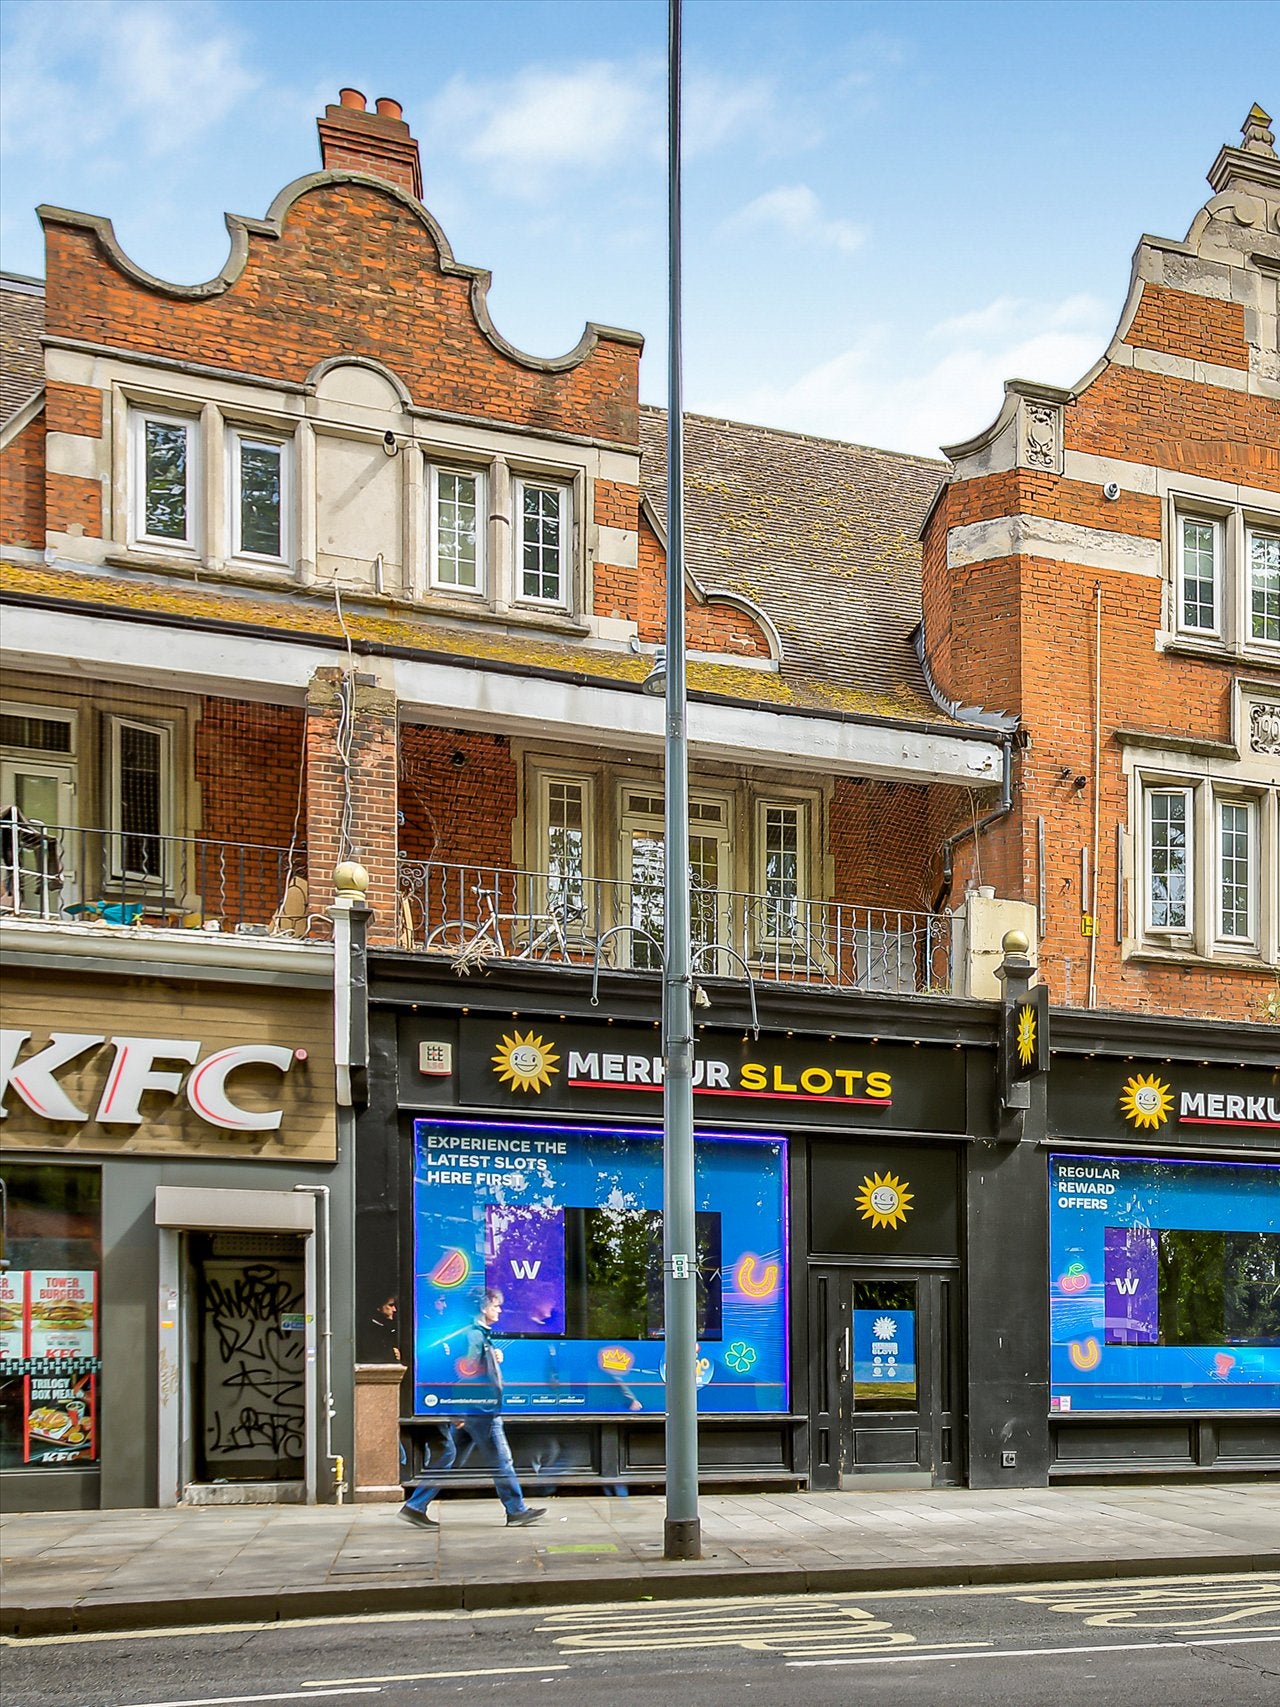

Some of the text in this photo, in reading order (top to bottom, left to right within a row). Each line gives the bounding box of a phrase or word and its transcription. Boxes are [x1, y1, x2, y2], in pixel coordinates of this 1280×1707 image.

[0, 1029, 294, 1130] KFC
[739, 1063, 892, 1098] SLOTS
[427, 1136, 567, 1154] EXPERIENCE THE
[427, 1153, 547, 1170] LATEST SLOTS
[427, 1171, 523, 1186] HERE FIRST
[1058, 1166, 1120, 1179] REGULAR
[1058, 1181, 1115, 1195] REWARD
[1058, 1197, 1108, 1210] OFFERS
[46, 1277, 79, 1288] TOWER
[39, 1289, 85, 1299] BURGERS
[32, 1378, 70, 1389] TRILOGY
[32, 1389, 75, 1400] BOX MEAL
[41, 1451, 80, 1462] KFC
